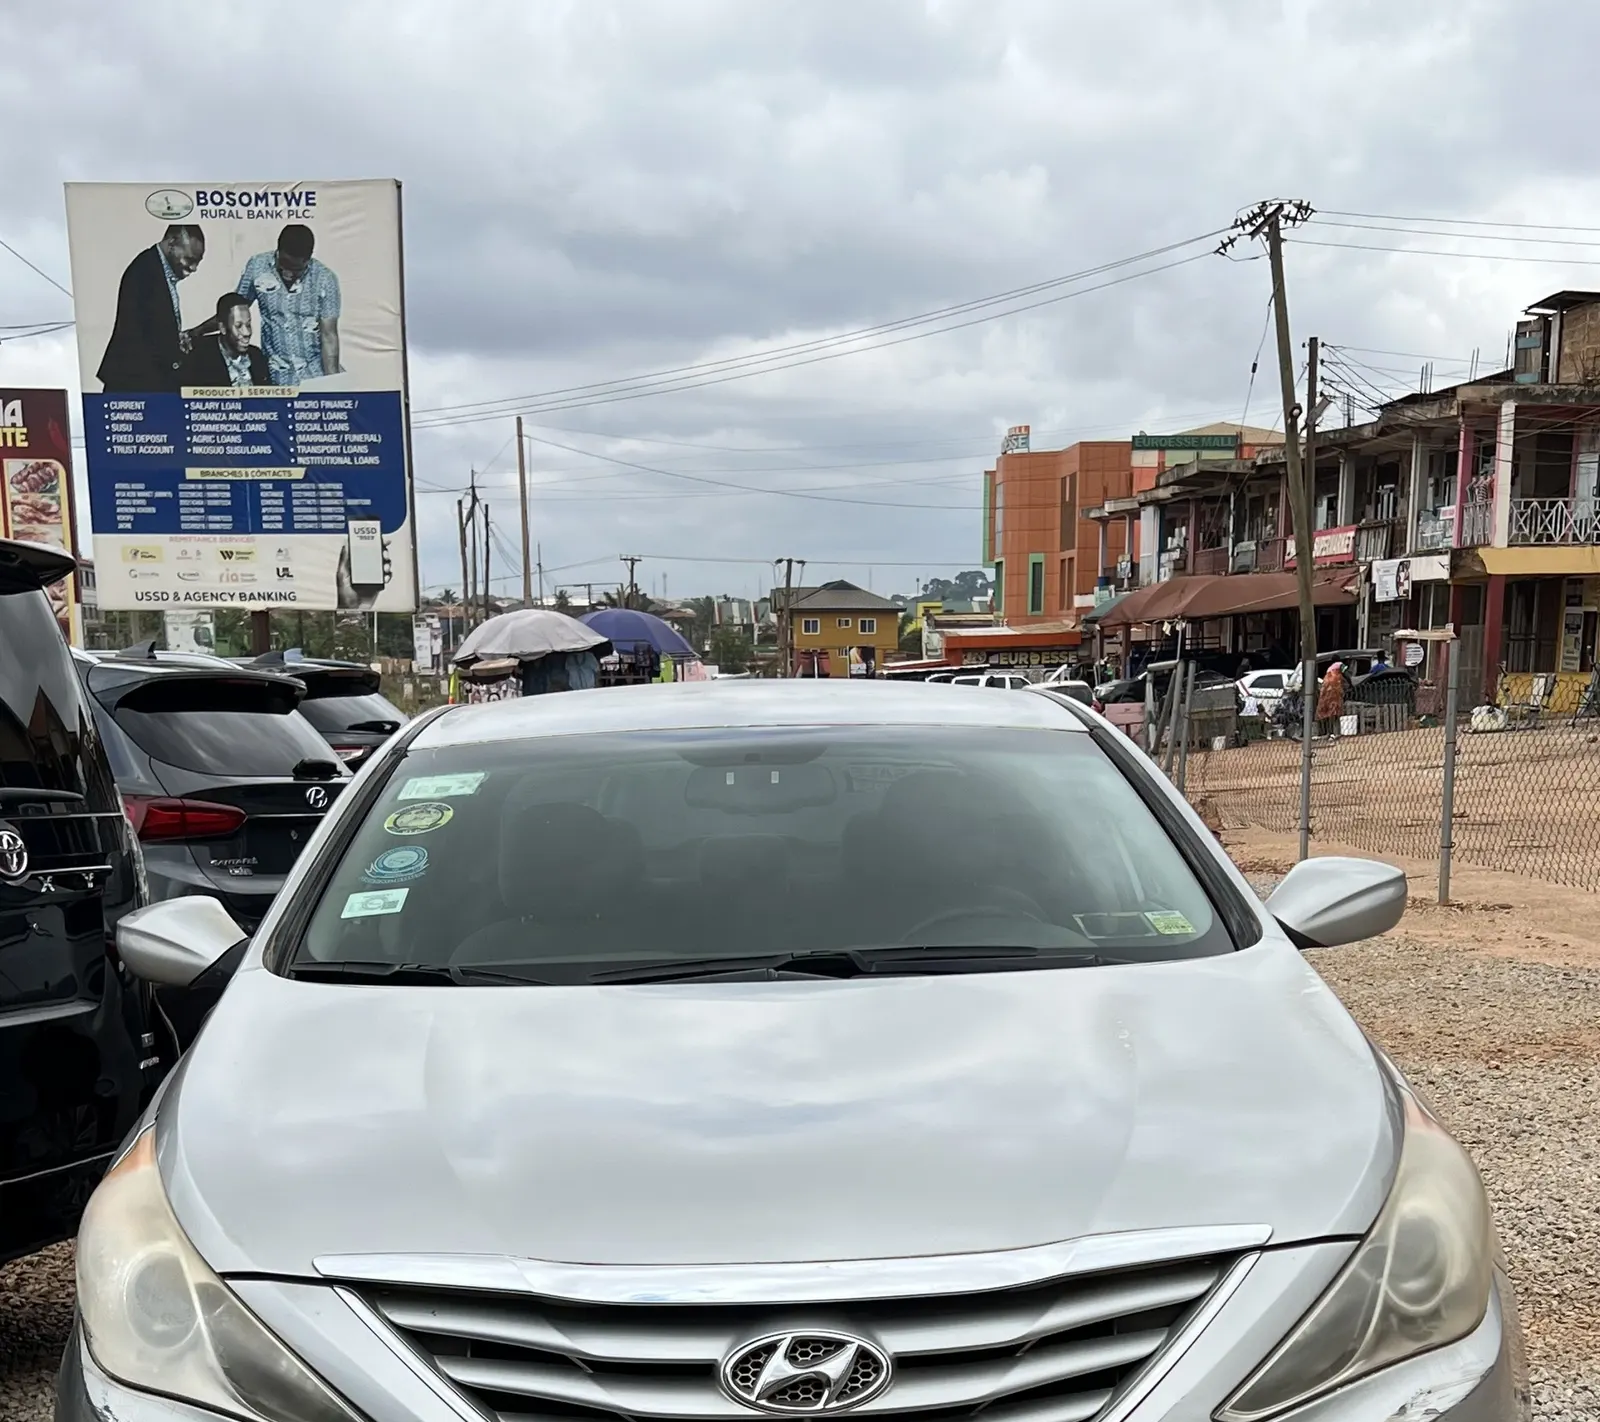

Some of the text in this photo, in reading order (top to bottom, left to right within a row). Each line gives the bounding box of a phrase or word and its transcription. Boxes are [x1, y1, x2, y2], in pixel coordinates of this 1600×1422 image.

[195, 190, 316, 207] BOSOMTWE
[201, 209, 314, 219] RURAL BANK PLC.
[248, 388, 292, 396] SERVICES
[109, 401, 145, 410] CURRENT
[190, 402, 241, 410] SALARY LOAN
[294, 400, 319, 409] MICRO
[320, 400, 353, 409] FINANCE
[110, 412, 143, 421] SAVINGS
[190, 412, 227, 421] BONANZA
[294, 411, 348, 420] GROUP LOANS
[111, 423, 132, 432] SUSU
[191, 423, 241, 432] COMMERCIAL
[295, 423, 350, 432] SOCIAL LOANS
[112, 434, 167, 443] FIXED DEPOSIT
[192, 435, 242, 443] AGRIC LOANS
[295, 434, 338, 444] (MARRIAGE
[344, 433, 382, 444] FUNERAL)
[1134, 436, 1236, 448] EUROESSE MALL
[113, 445, 174, 454] TRUST ACCOUNT
[296, 445, 369, 454] TRANSPORT LOANS
[297, 456, 380, 465] INSTITUTIONAL LOANS
[200, 470, 240, 478] BRANCHES
[250, 470, 292, 478] CONTACTS
[135, 591, 297, 601] USSD & AGENCY BANKING
